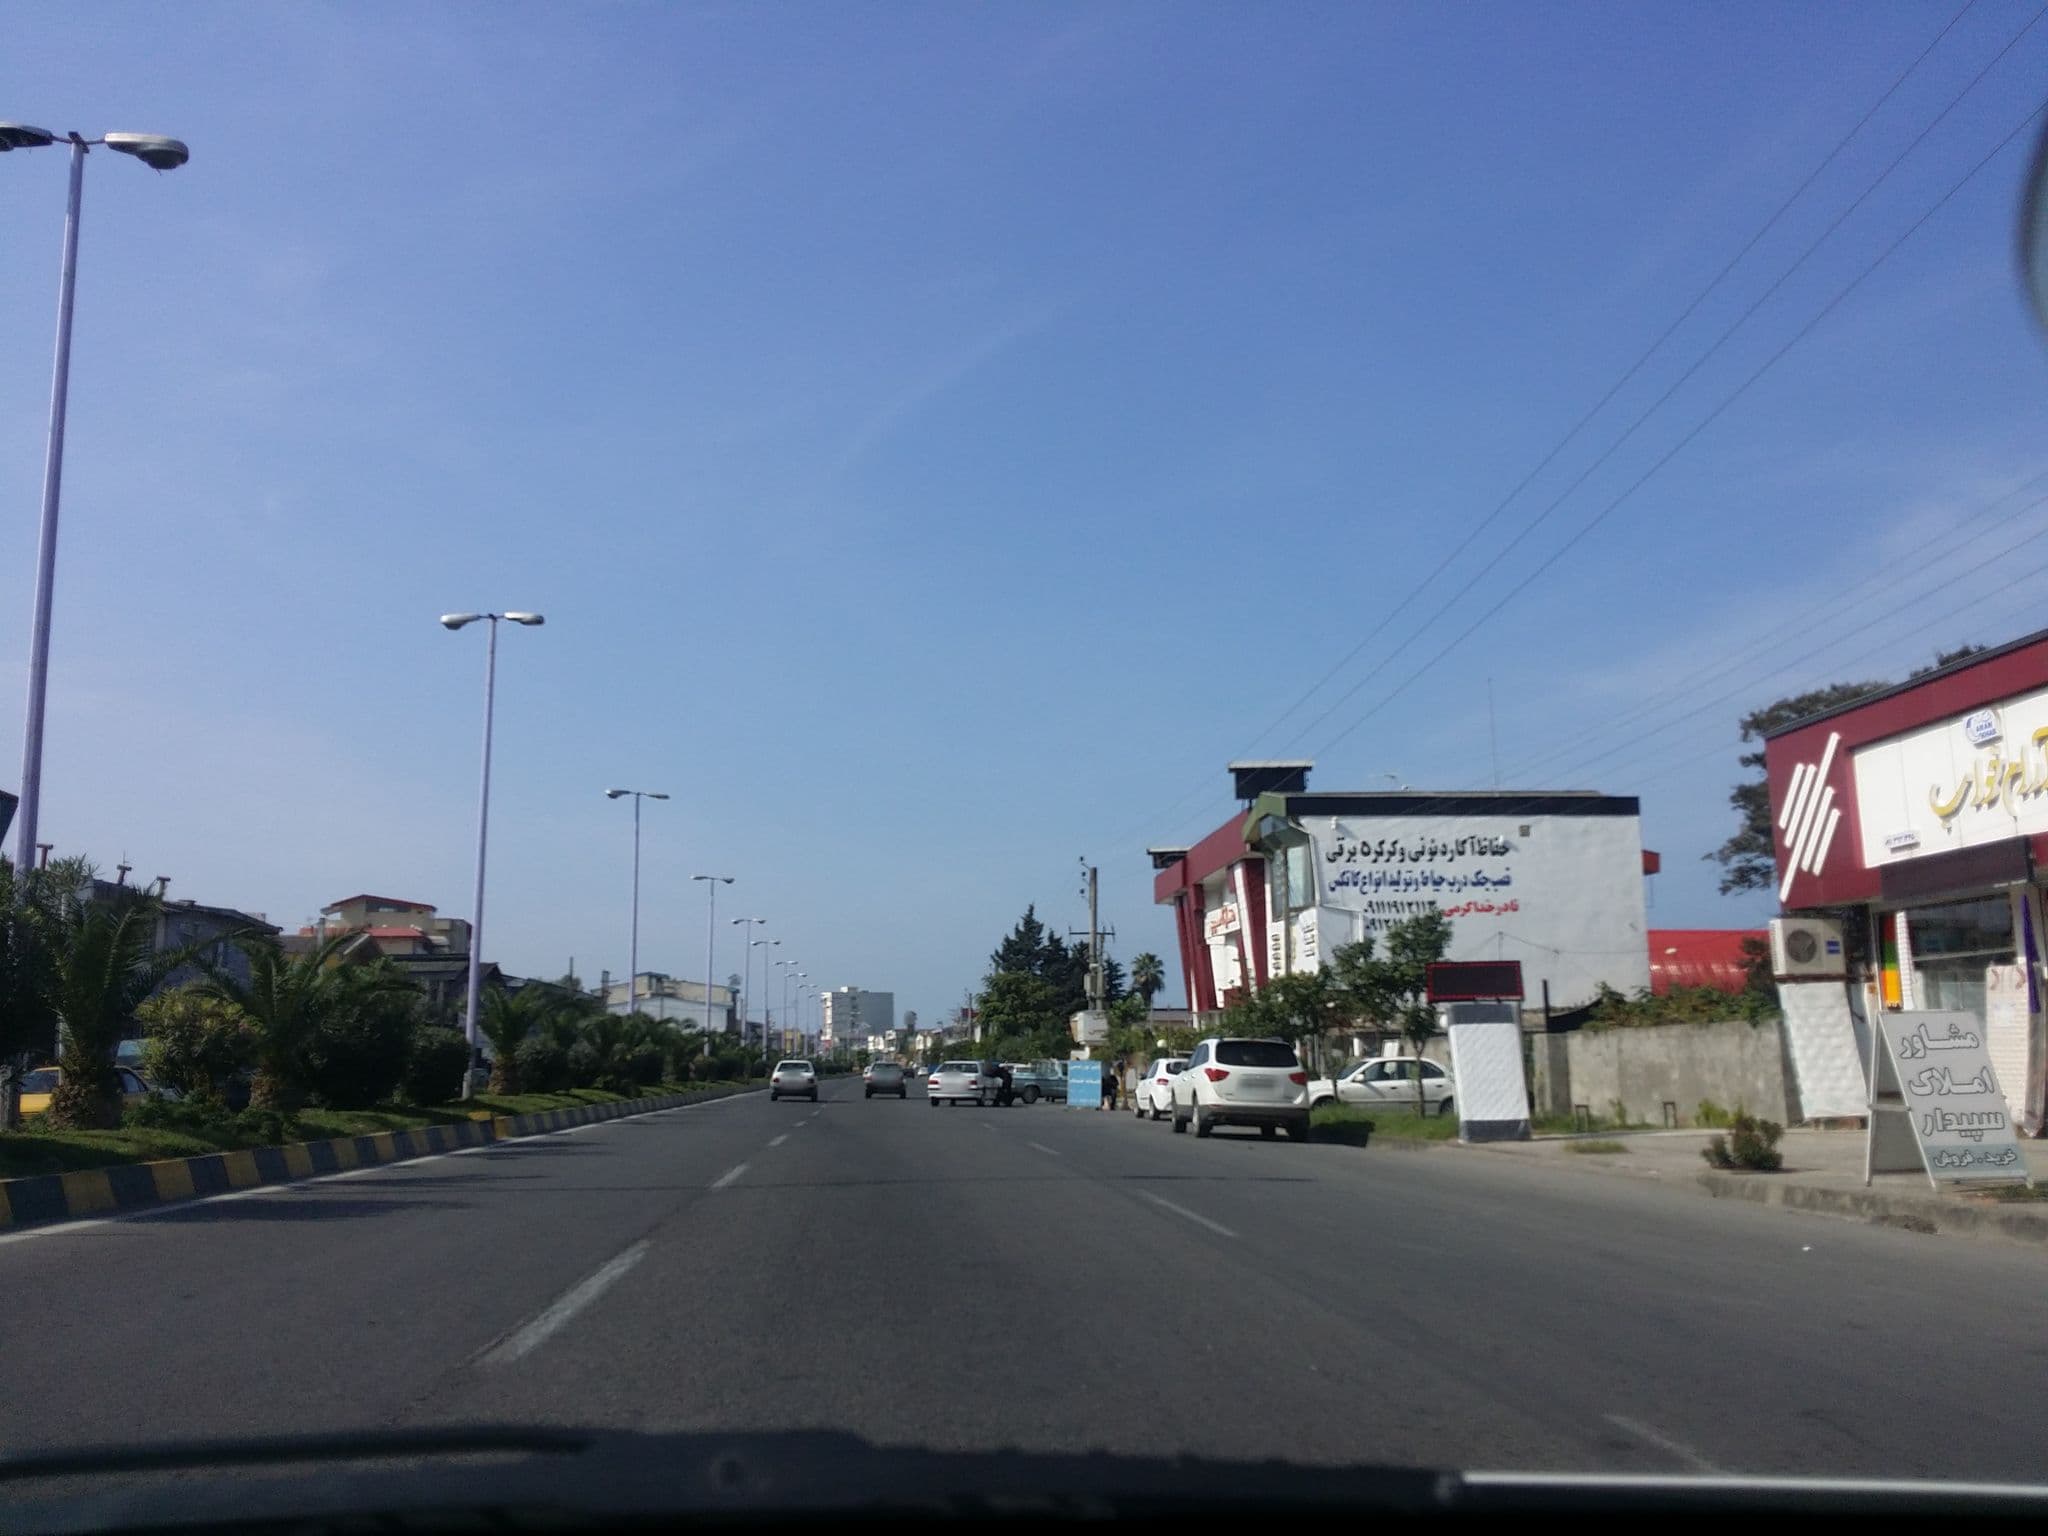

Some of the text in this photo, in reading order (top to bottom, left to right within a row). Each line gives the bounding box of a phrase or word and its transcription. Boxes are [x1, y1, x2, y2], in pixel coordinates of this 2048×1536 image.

[1326, 837, 1357, 863] برقی
[1328, 870, 1361, 893] کانکس
[1360, 870, 1387, 895] انواع
[1388, 870, 1414, 893] تولید
[1421, 870, 1446, 892] حیاط
[1447, 874, 1468, 893] درب
[1491, 867, 1512, 892] نصب
[1495, 898, 1520, 916] نادر
[1899, 1022, 1980, 1059] مشاور
[1908, 1065, 1995, 1096] املاک
[1922, 1107, 2005, 1142] سپیدار
[1933, 1148, 2018, 1168] خرید فروش
